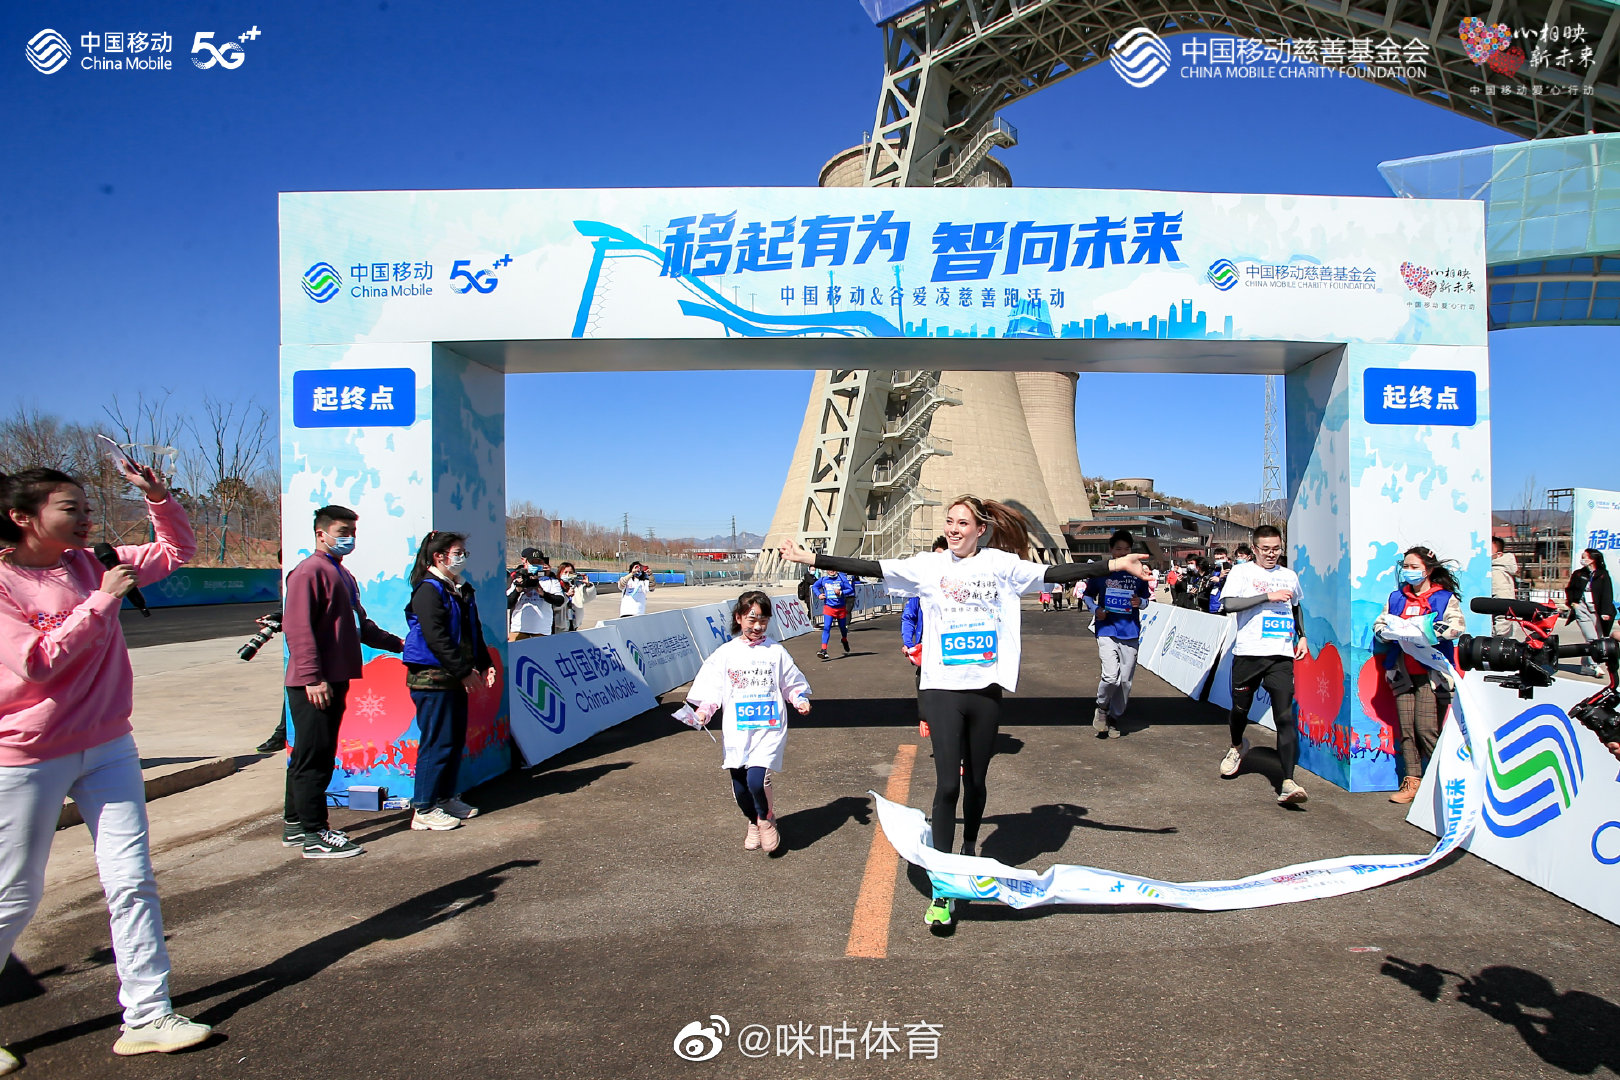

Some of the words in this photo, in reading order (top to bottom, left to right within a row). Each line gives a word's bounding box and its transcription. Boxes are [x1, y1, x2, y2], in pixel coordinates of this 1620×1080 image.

[659, 209, 911, 279] 移起有为
[930, 210, 1184, 282] 智向未来
[350, 261, 433, 283] 中国移动
[1245, 264, 1377, 283] 中国移动慈善基金会
[351, 285, 388, 298] China
[391, 283, 433, 297] Mobile
[1245, 280, 1268, 288] CHINA
[1269, 281, 1296, 289] MOBILE
[1297, 281, 1328, 289] CHARITY
[1329, 282, 1376, 290] FOUNDATION
[1439, 280, 1476, 294] 新未来
[780, 285, 1065, 308] 中国移动&谷爱凌慈善跑活动
[312, 385, 394, 412] 起终点
[1382, 384, 1459, 410] 起终点
[944, 635, 994, 651] 5G520
[555, 643, 625, 686] 中国移动
[575, 686, 610, 713] China
[609, 677, 639, 703] Mobile
[737, 704, 776, 716] 5G121
